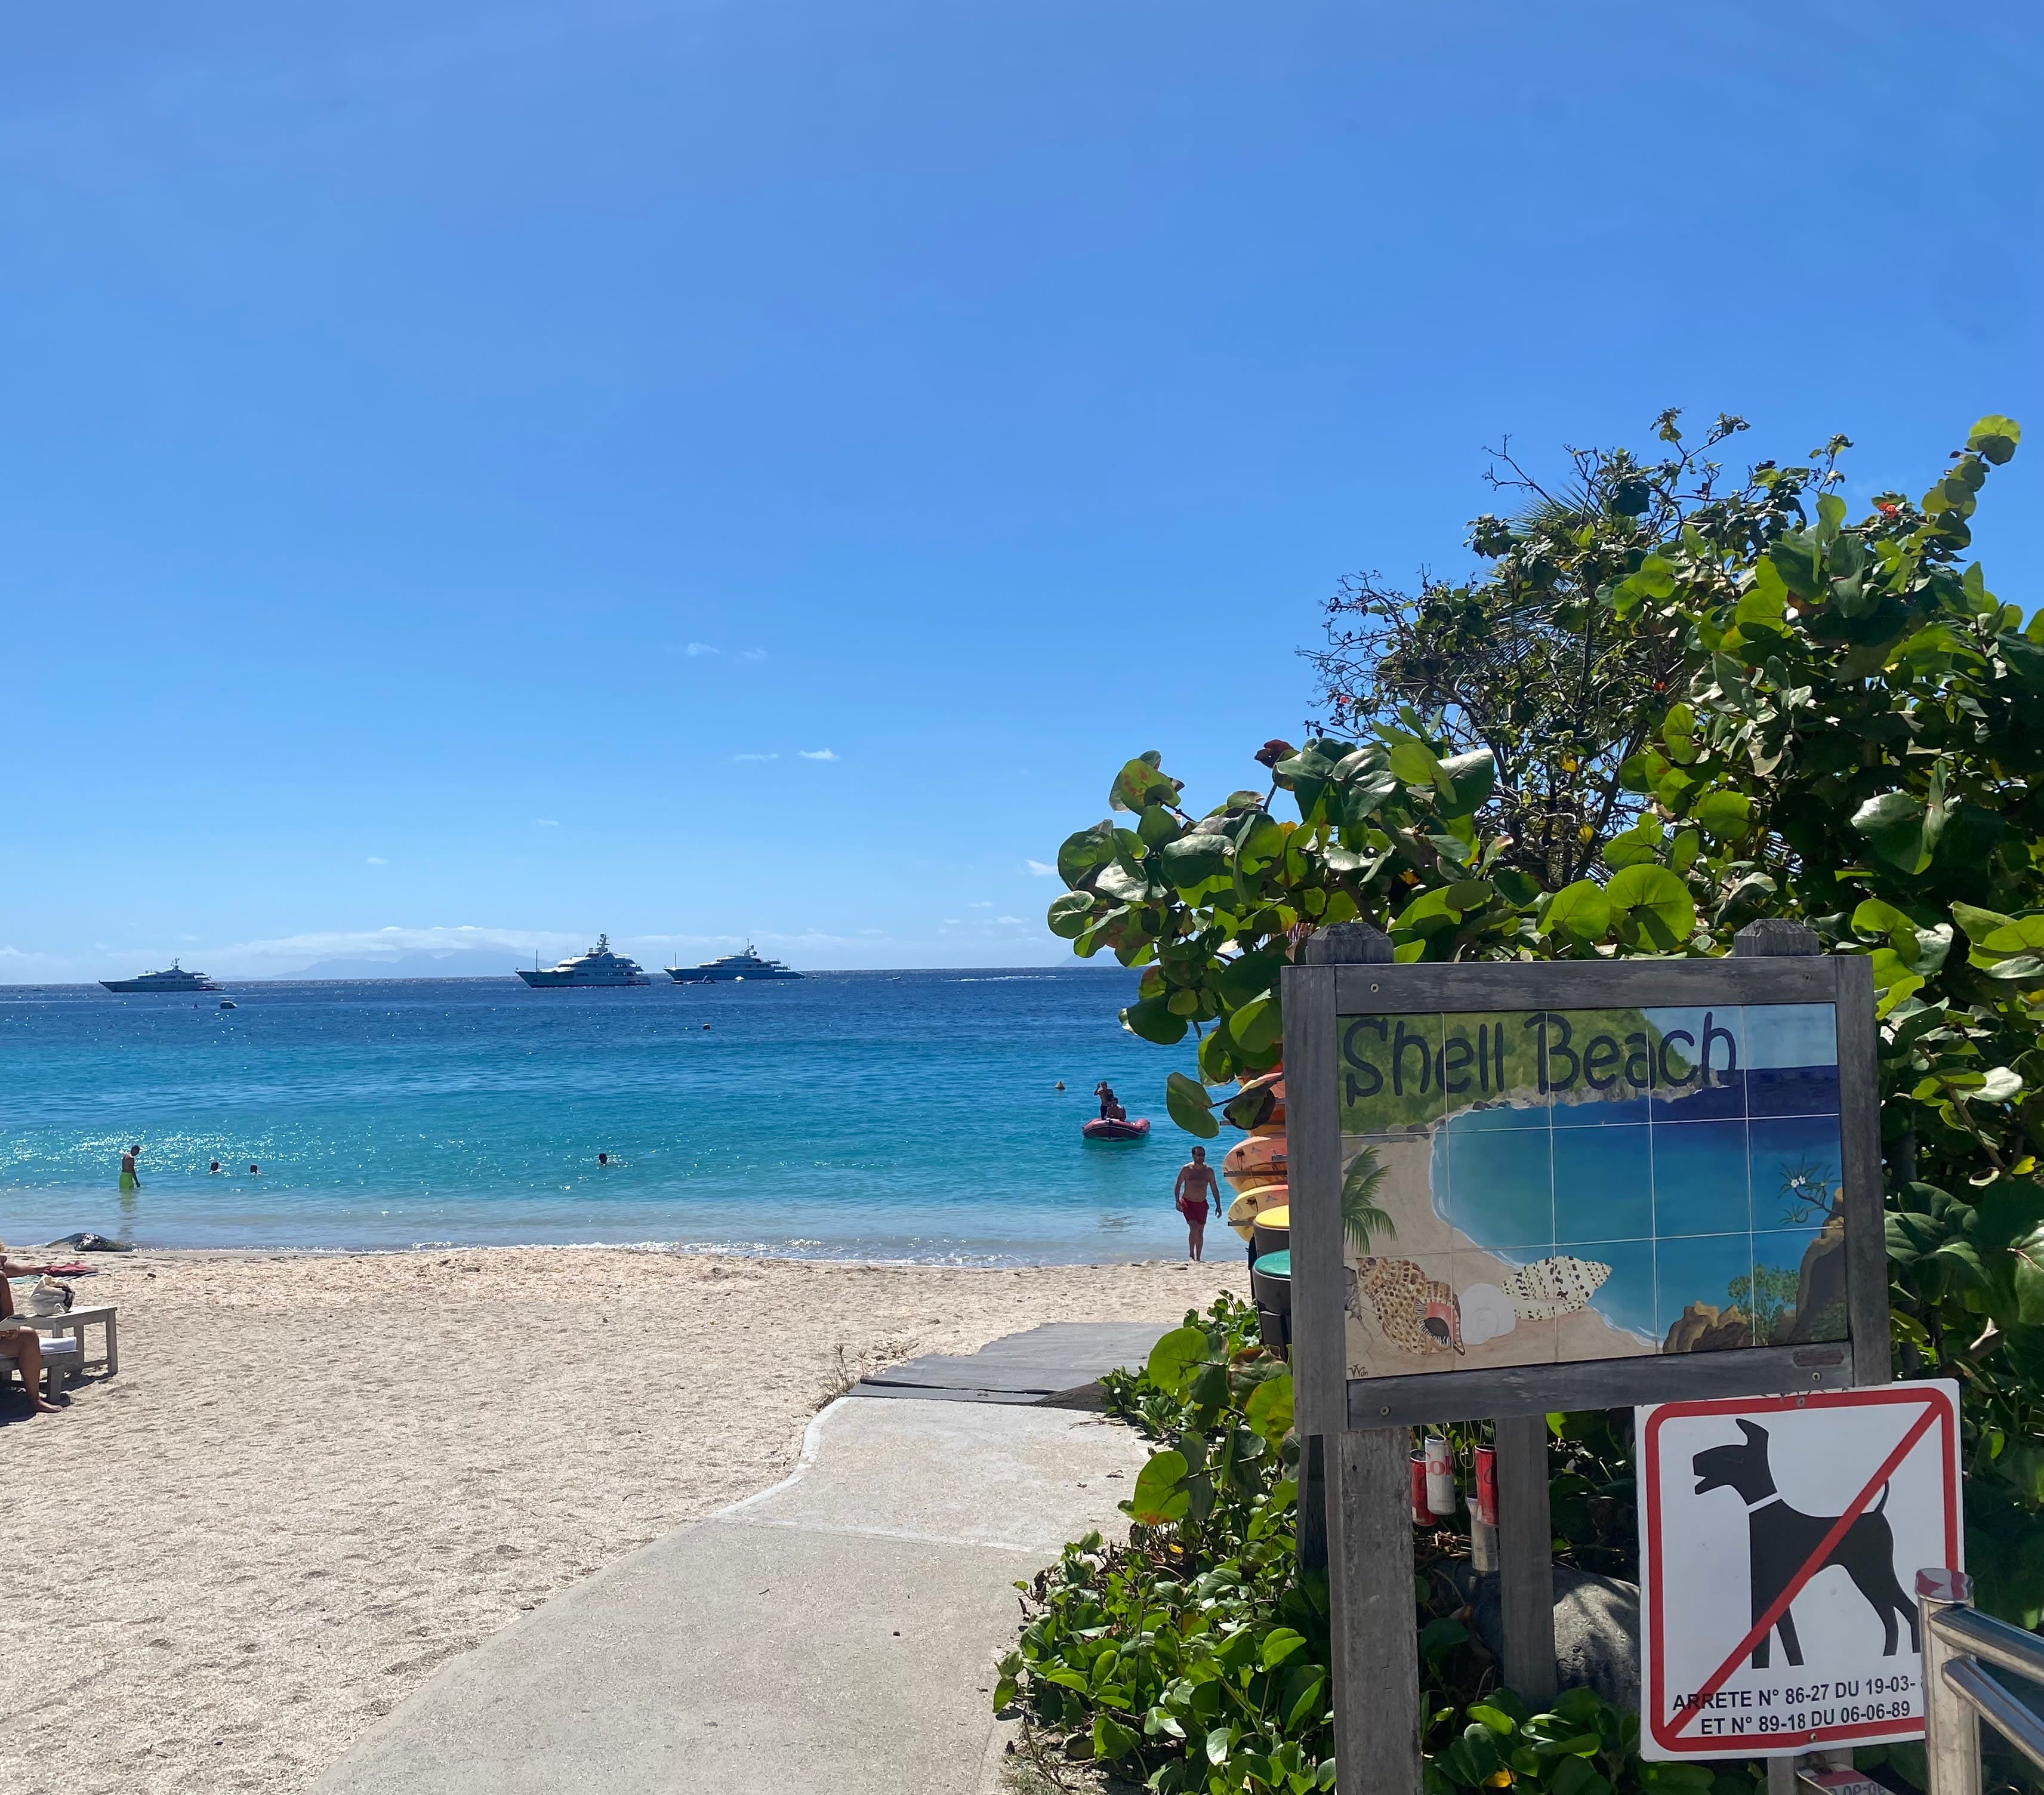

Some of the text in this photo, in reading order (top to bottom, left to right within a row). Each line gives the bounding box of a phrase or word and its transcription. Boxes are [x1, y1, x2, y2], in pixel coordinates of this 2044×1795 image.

[1343, 1011, 1737, 1107] Shell Beach
[1673, 1691, 1752, 1711] ARRETE
[1759, 1689, 1779, 1706] N°
[1785, 1684, 1829, 1705] 86-27
[1835, 1681, 1860, 1698] DU
[1701, 1701, 1910, 1735] ET N° 89-18 DU 06-06-89
